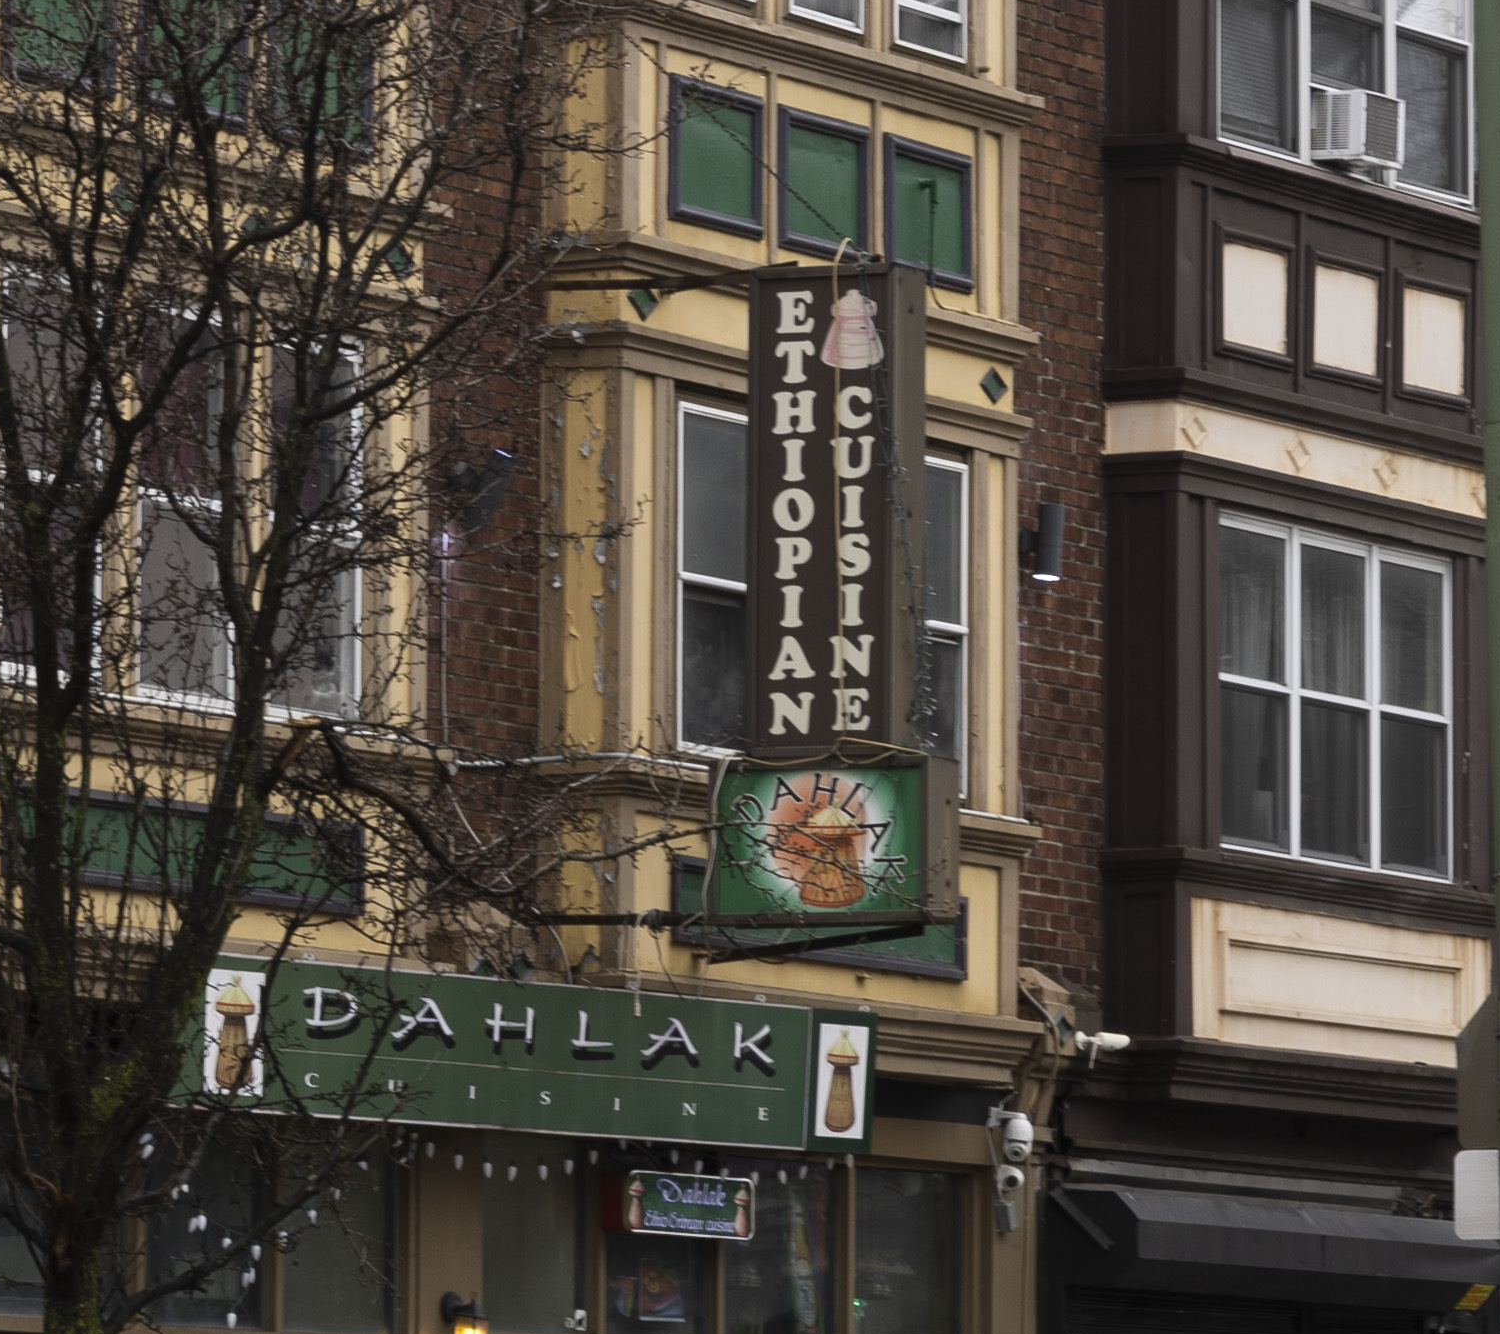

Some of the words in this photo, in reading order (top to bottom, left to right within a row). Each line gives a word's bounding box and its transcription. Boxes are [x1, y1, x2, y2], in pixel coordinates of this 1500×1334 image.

[768, 289, 817, 736] ETHIOPIAN
[830, 385, 875, 734] CUISINE
[732, 772, 908, 895] DAHLAK
[304, 985, 775, 1064] DAHLAK
[304, 1071, 771, 1122] CUISINE
